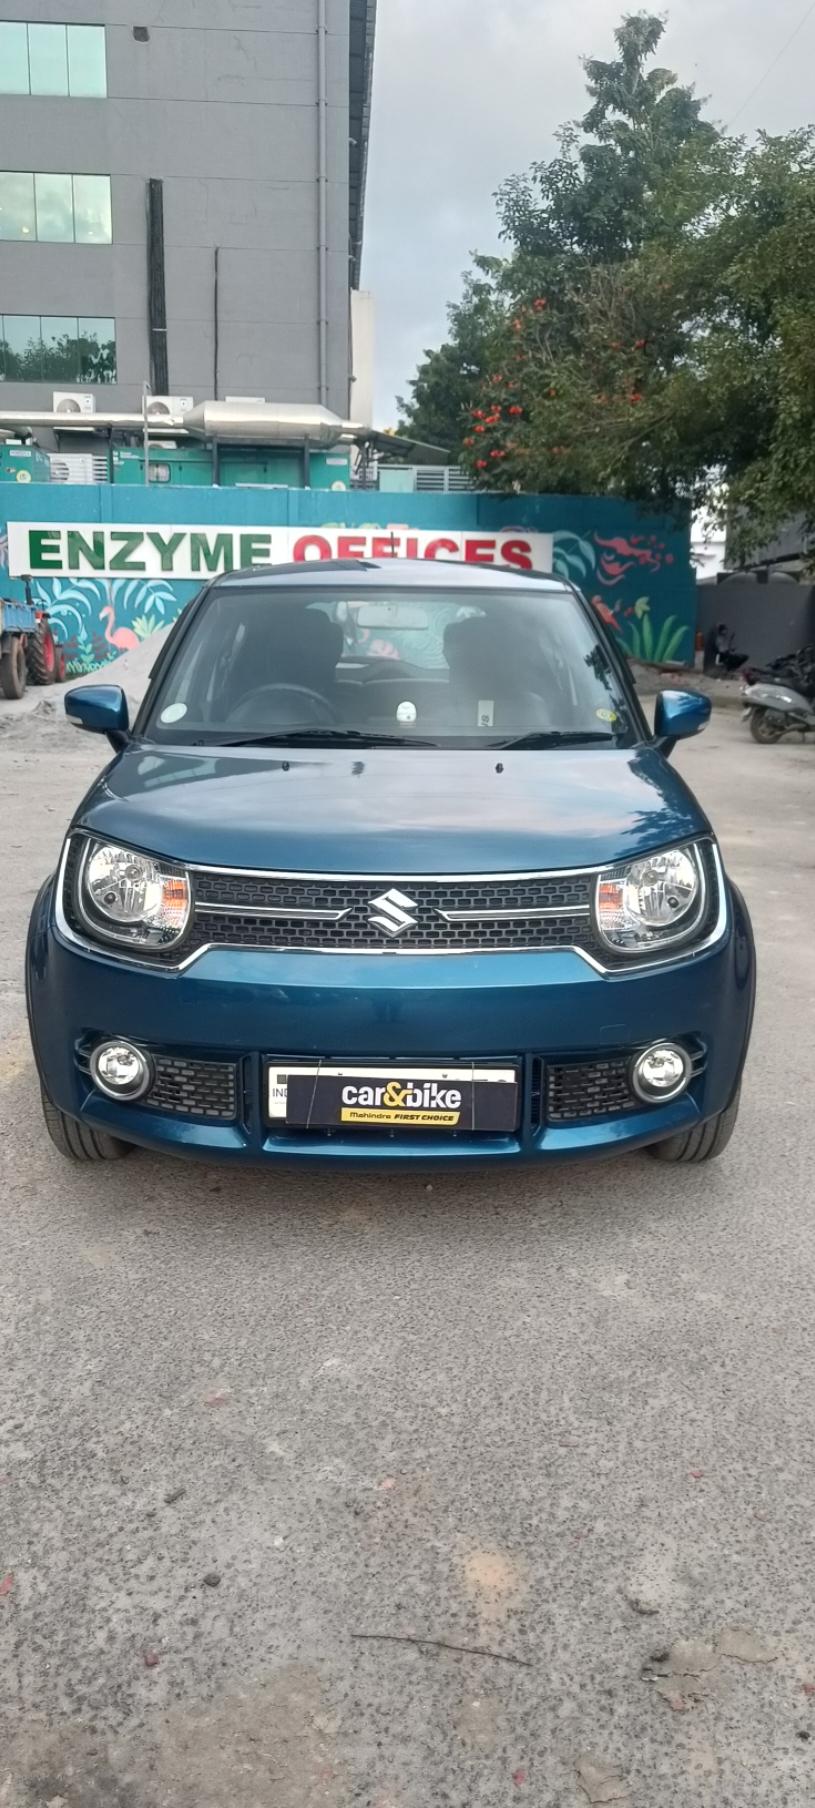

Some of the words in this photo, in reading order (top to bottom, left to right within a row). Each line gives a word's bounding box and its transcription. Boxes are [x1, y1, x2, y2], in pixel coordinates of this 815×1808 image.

[28, 530, 272, 571] ENZYME
[341, 1081, 462, 1109] car&bike
[349, 1112, 391, 1120] Mahindra
[394, 1113, 421, 1121] FIRST
[421, 1114, 455, 1122] CHOICE
